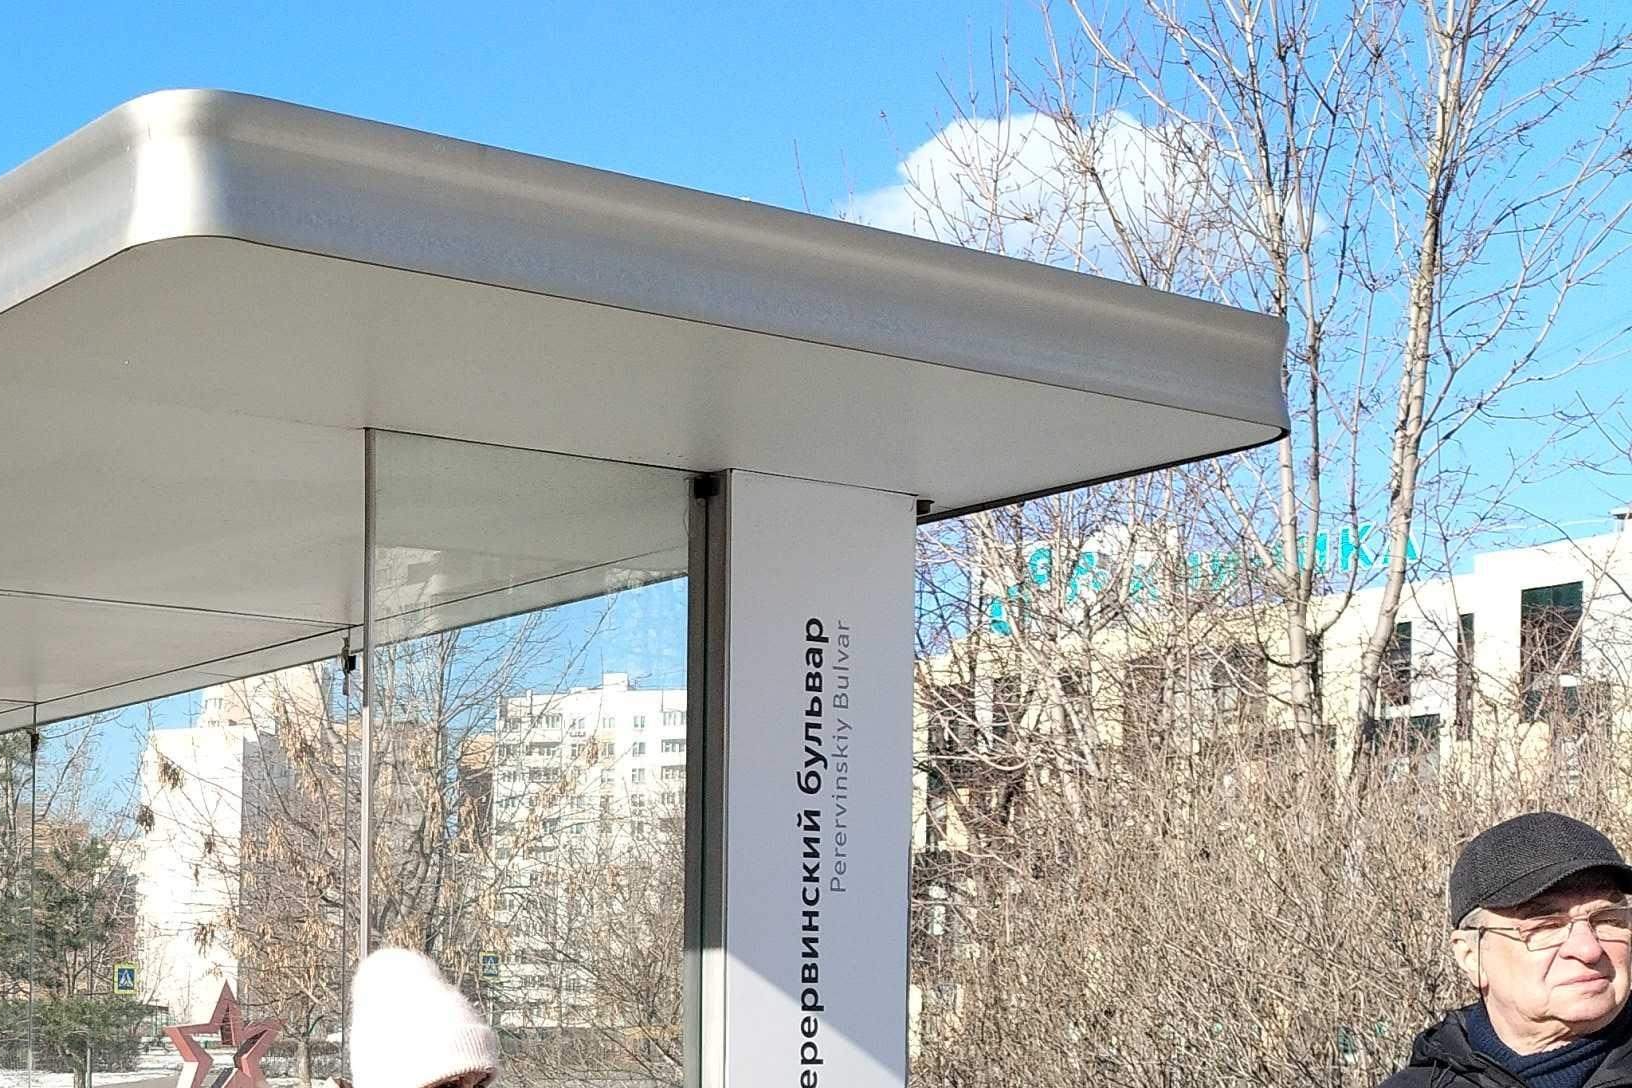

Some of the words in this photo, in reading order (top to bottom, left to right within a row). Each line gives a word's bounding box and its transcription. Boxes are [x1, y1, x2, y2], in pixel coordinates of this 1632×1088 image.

[796, 617, 829, 795] бульвар
[832, 619, 850, 709] Bulvar
[830, 718, 853, 892] Perervinskiy
